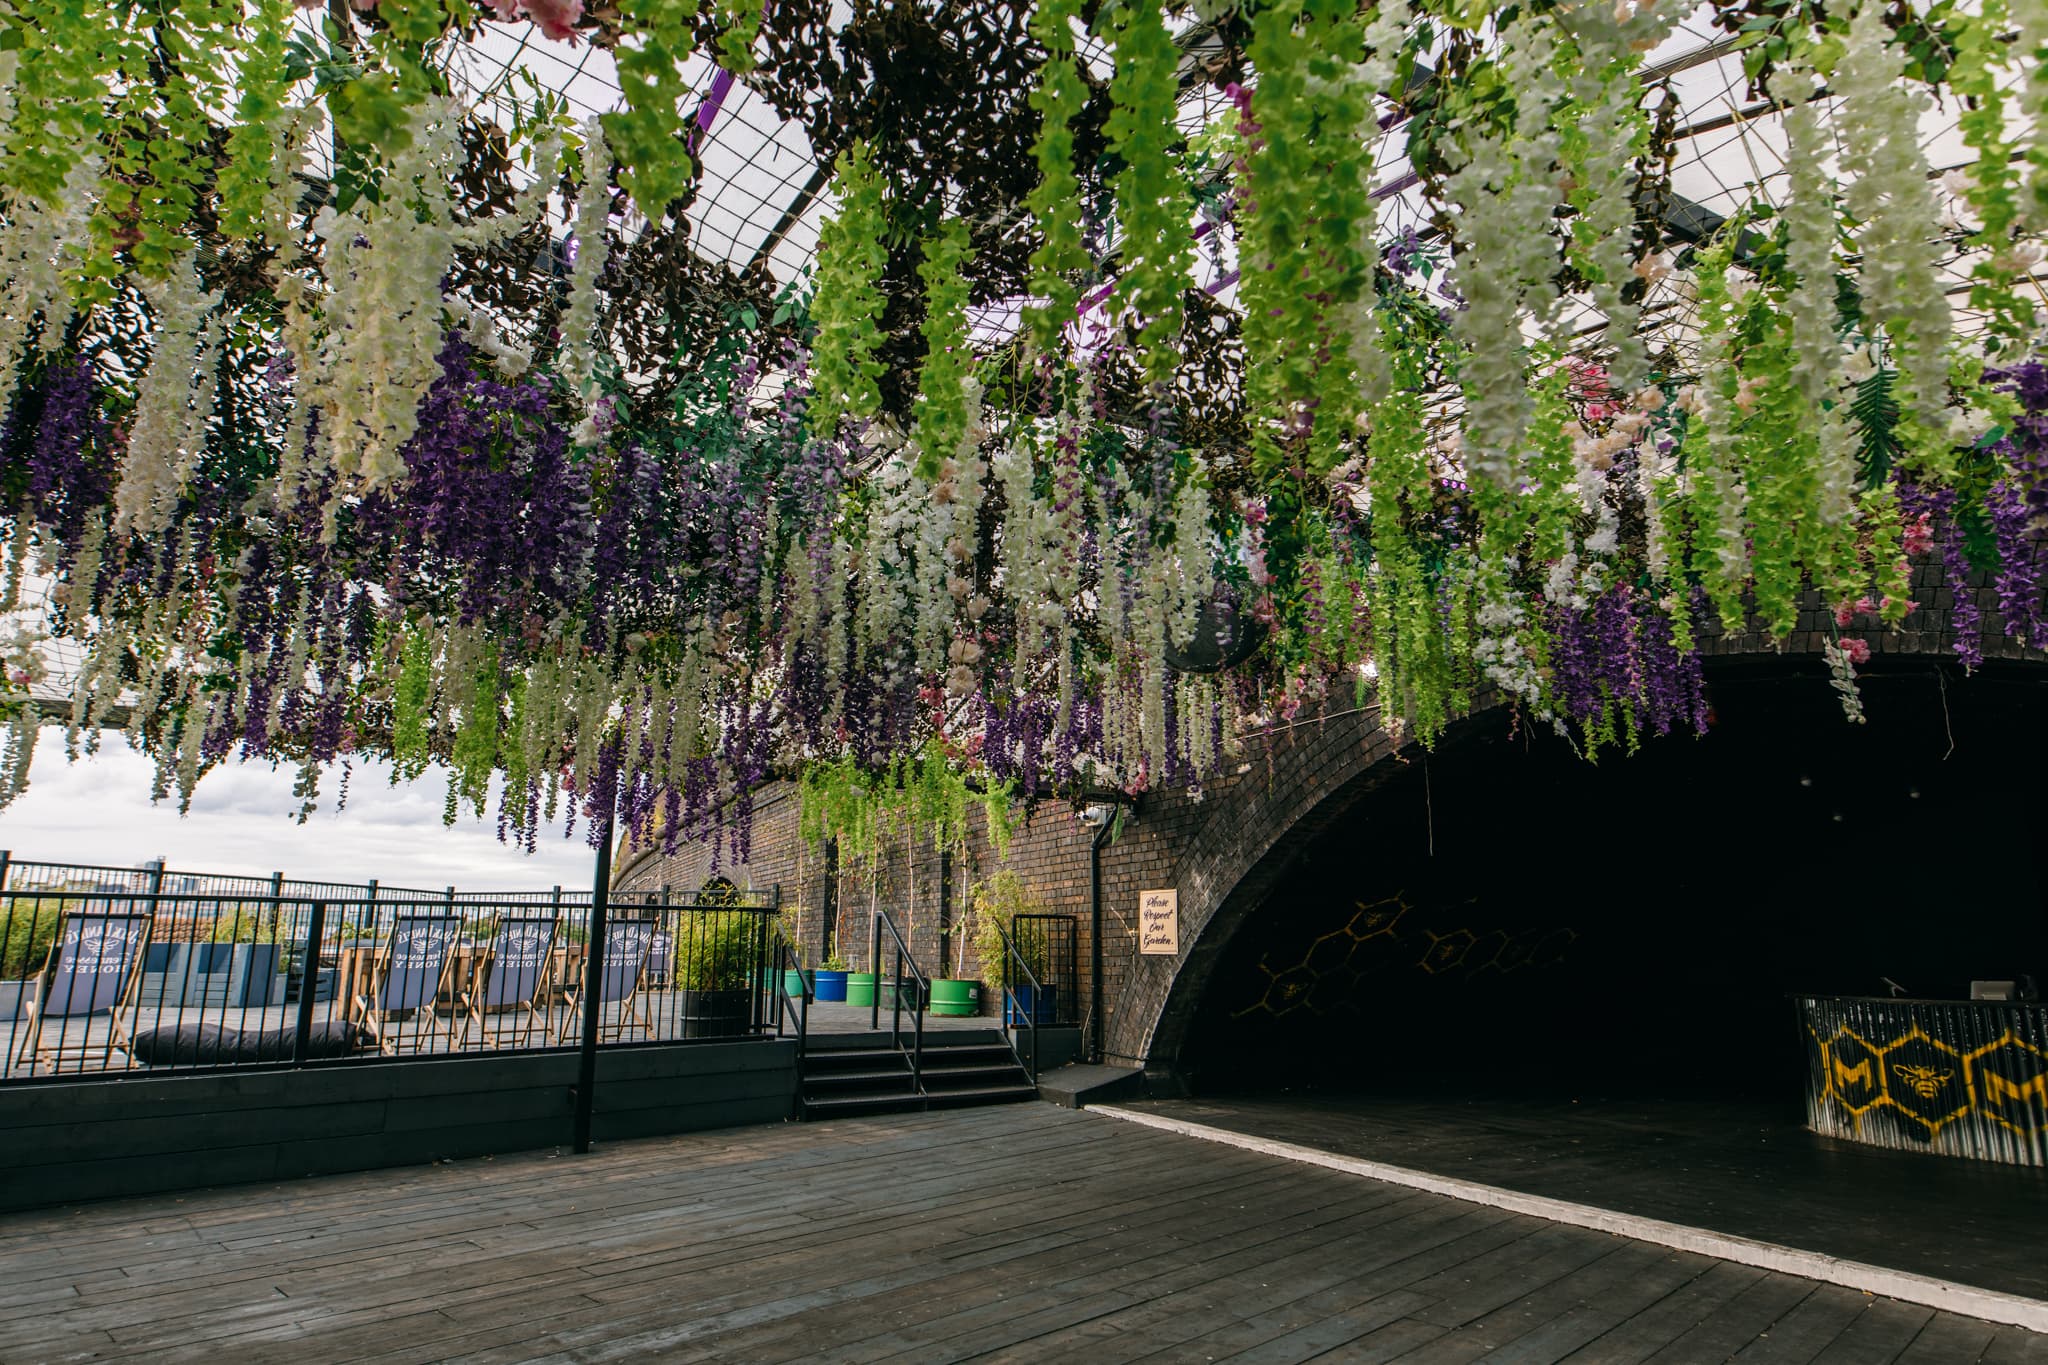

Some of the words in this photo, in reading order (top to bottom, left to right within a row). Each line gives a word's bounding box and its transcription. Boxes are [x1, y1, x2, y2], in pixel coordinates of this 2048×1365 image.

[1146, 896, 1168, 907] Please
[1144, 909, 1173, 921] Respect
[1150, 921, 1164, 932] Our
[1144, 934, 1174, 949] Garden.
